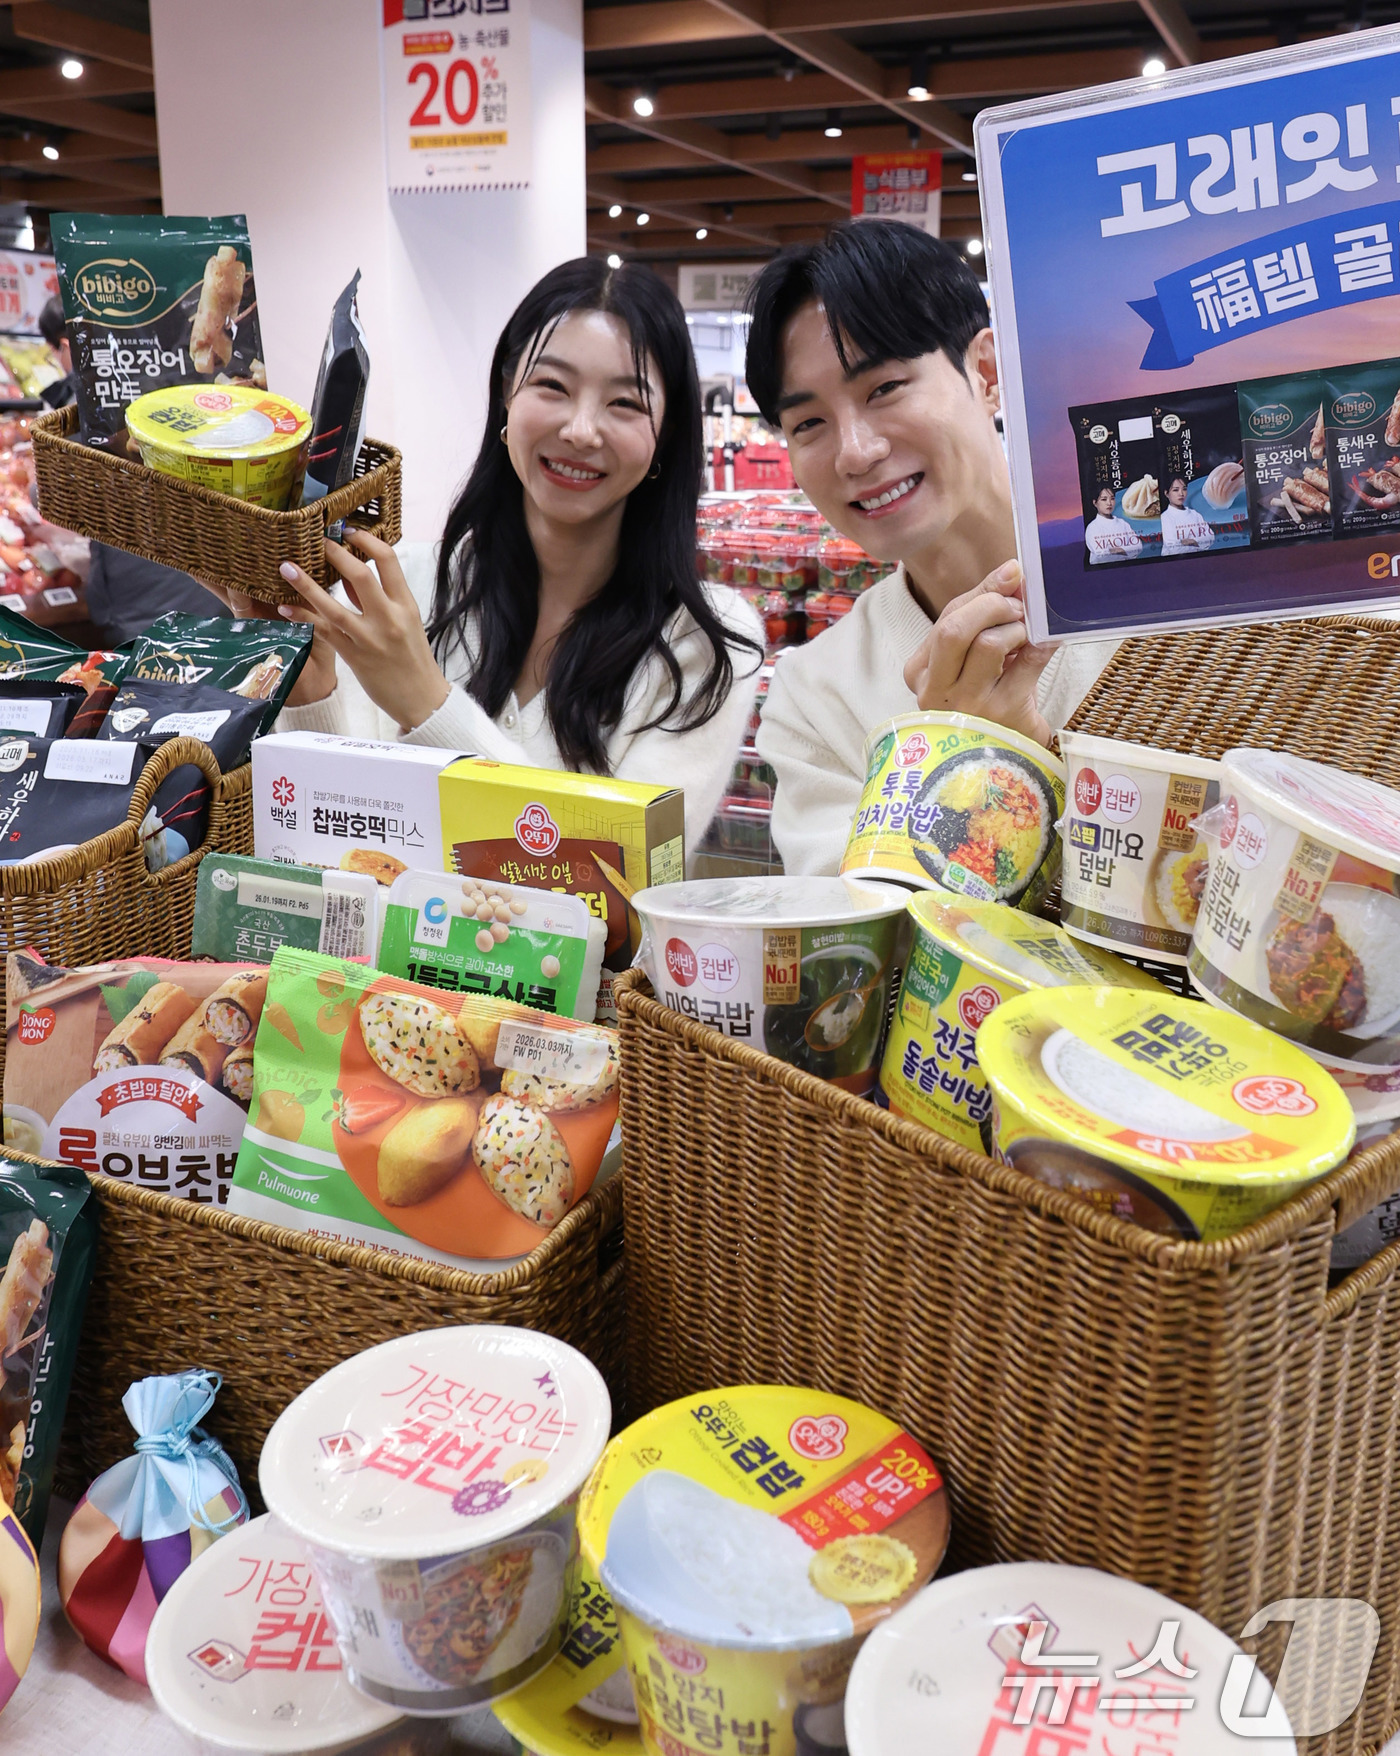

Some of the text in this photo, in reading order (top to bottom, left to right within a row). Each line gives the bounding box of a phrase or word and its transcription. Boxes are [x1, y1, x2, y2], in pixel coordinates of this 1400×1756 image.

[1096, 103, 1379, 238] 고래잇
[82, 273, 151, 300] bibigo
[96, 294, 126, 304] 비비고
[90, 348, 187, 378] 통오징어
[1252, 412, 1290, 426] bibigo
[1335, 401, 1373, 416] bibigo
[1336, 433, 1378, 452] 통새우
[1254, 447, 1307, 469] 통오징어
[1337, 452, 1366, 469] 만두
[1255, 468, 1284, 485] 만두
[970, 734, 985, 744] UP
[881, 770, 924, 799] 톡톡
[1076, 779, 1099, 807] 햇반
[313, 790, 346, 804] 찹쌀가루를
[347, 796, 368, 808] 사용해
[368, 799, 382, 810] 더욱
[1105, 787, 1137, 814] 컵반
[270, 806, 297, 830] 백설
[312, 806, 425, 848] 찹쌀호떡믹스
[855, 802, 943, 834] 김치알밥
[1164, 807, 1199, 834] No.1
[524, 829, 551, 846] 오뚜기
[1069, 823, 1096, 846] 스팸
[1101, 826, 1145, 861] 마요
[499, 860, 547, 885] 발효시간
[1079, 851, 1117, 888] 덮밥
[253, 918, 271, 930] 국산
[422, 926, 443, 940] 청정원
[768, 935, 797, 947] 컵밥류
[409, 946, 515, 978] 맷돌방식으로 갈아 고소한
[667, 950, 694, 977] 햇반
[701, 956, 734, 982] 컵반
[765, 962, 798, 985] No.1
[21, 1012, 51, 1029] DONG
[966, 1003, 986, 1023] 오뚜
[21, 1027, 45, 1039] WON
[515, 1033, 573, 1057] 2026.03.03까지
[512, 1045, 542, 1061] FW P01
[114, 1080, 159, 1104] 초밥의
[102, 1132, 120, 1147] 펼친
[153, 1135, 196, 1150] 양반김에
[257, 1171, 320, 1204] Pulmuone
[381, 1364, 578, 1453] 가장맛있는
[690, 1404, 740, 1450] 오뚜기
[363, 1410, 509, 1498] 컵반
[730, 1436, 806, 1499] 컵밥
[881, 1448, 937, 1489] 20%
[865, 1466, 913, 1506] UP!
